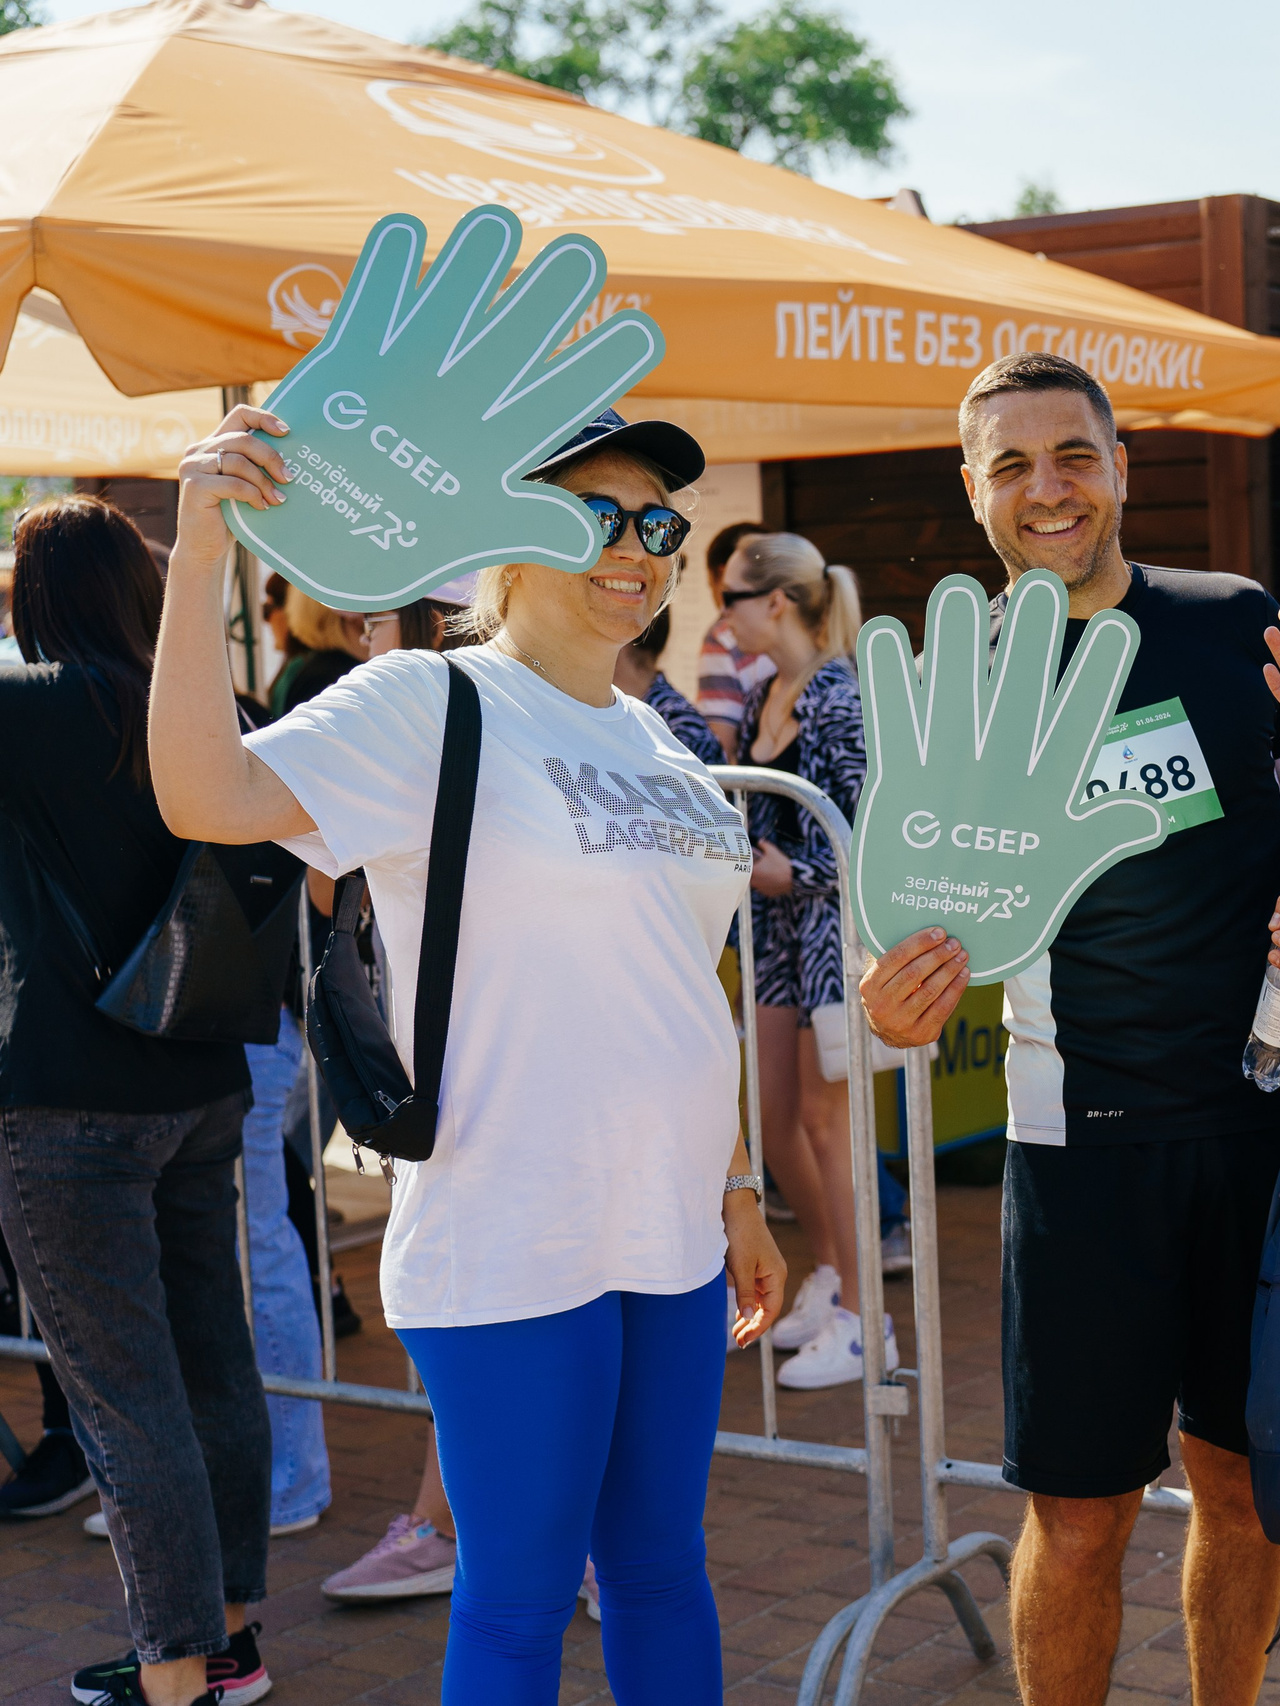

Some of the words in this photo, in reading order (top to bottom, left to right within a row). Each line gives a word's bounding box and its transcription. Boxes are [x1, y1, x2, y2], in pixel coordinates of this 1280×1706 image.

[774, 290, 905, 363] ПЕЙТЕ
[915, 311, 982, 369] БЕЗ
[370, 424, 461, 496] СБЕР
[297, 445, 384, 514] зелёный
[951, 823, 1041, 856] СБЕР
[891, 891, 979, 915] марафон
[904, 876, 989, 898] зелёный
[1086, 1110, 1125, 1118] DRI-FIT
